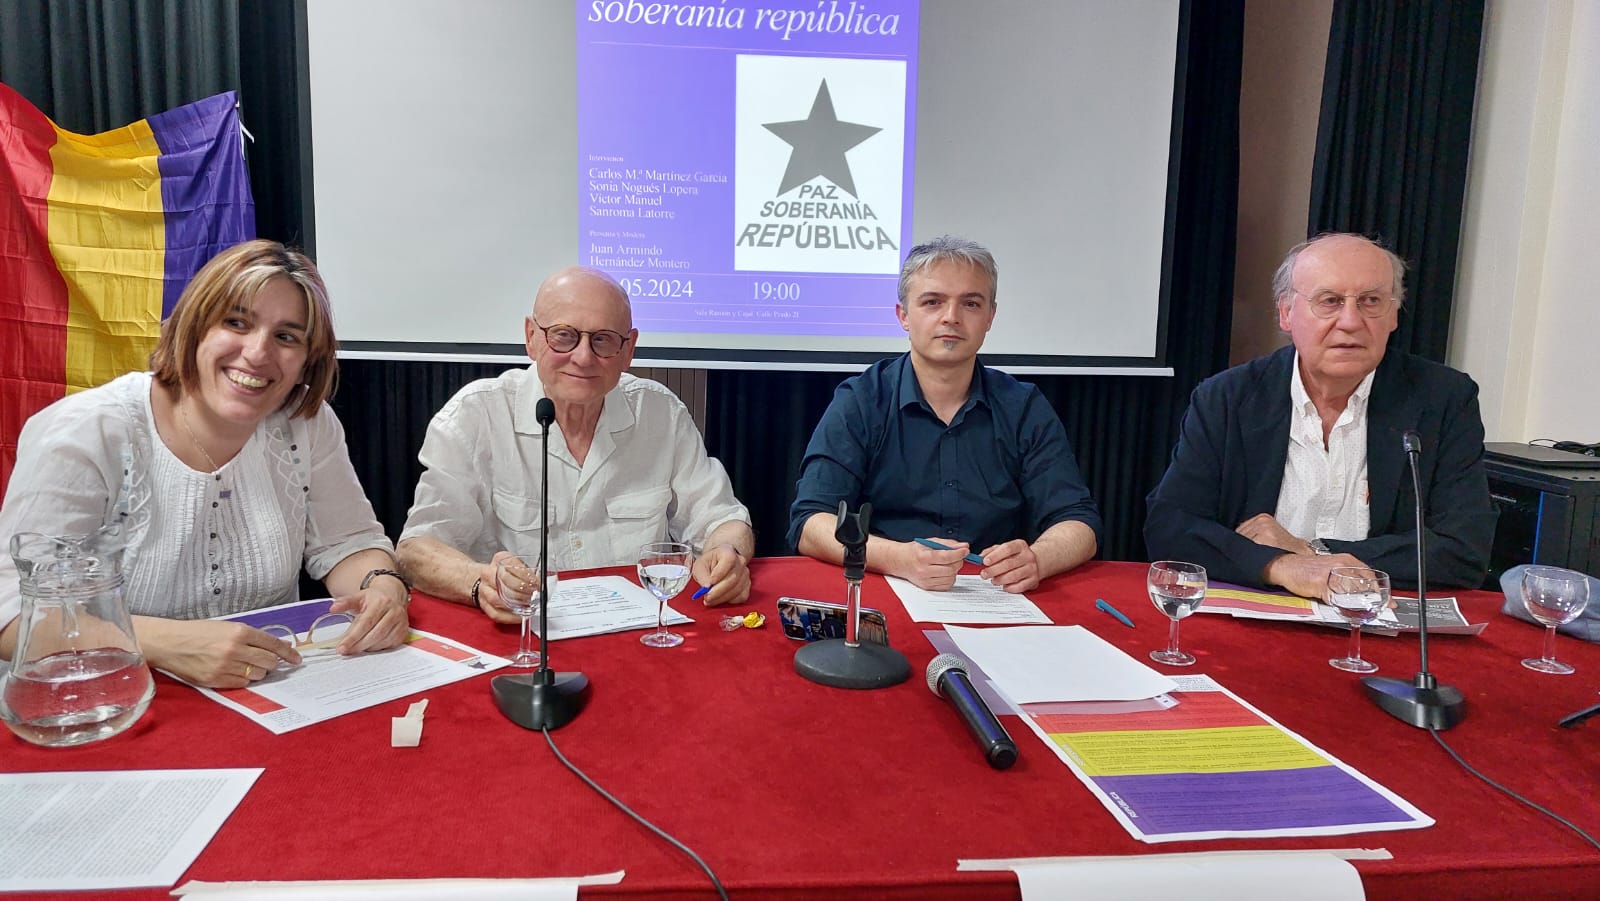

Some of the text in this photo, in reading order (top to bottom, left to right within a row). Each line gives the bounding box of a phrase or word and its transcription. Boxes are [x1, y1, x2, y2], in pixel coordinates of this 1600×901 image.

[588, 0, 900, 40] soberanía república
[589, 167, 622, 179] Carlos
[645, 169, 691, 182] Martínez
[589, 180, 699, 196] Sonia Nogués Lopera
[798, 185, 839, 200] PAZ
[624, 194, 662, 206] Manuel
[589, 205, 676, 219] Sanroma Latorre
[760, 200, 878, 220] SOBERANÍA
[736, 221, 899, 250] REPÚBLICA
[589, 243, 663, 256] Juan Armindo
[590, 255, 690, 269] Hernández Montero
[620, 278, 801, 301] 05.2024 19:00
